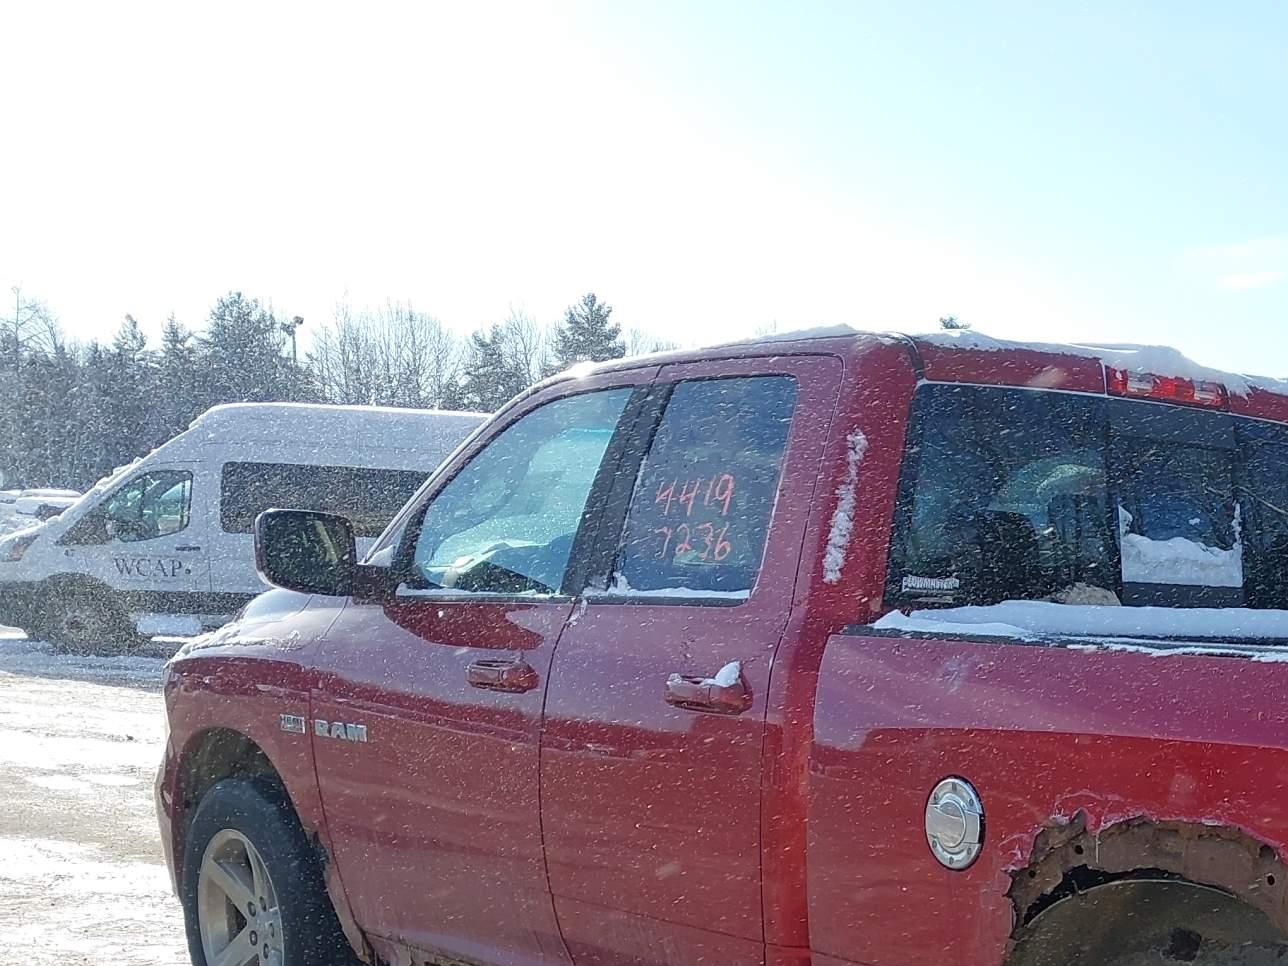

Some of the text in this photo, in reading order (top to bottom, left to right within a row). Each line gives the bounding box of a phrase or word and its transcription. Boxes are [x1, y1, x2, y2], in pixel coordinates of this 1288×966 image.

[655, 474, 733, 516] 4419
[655, 522, 731, 561] 7236
[114, 558, 182, 577] WCAP
[315, 719, 368, 743] RAM
